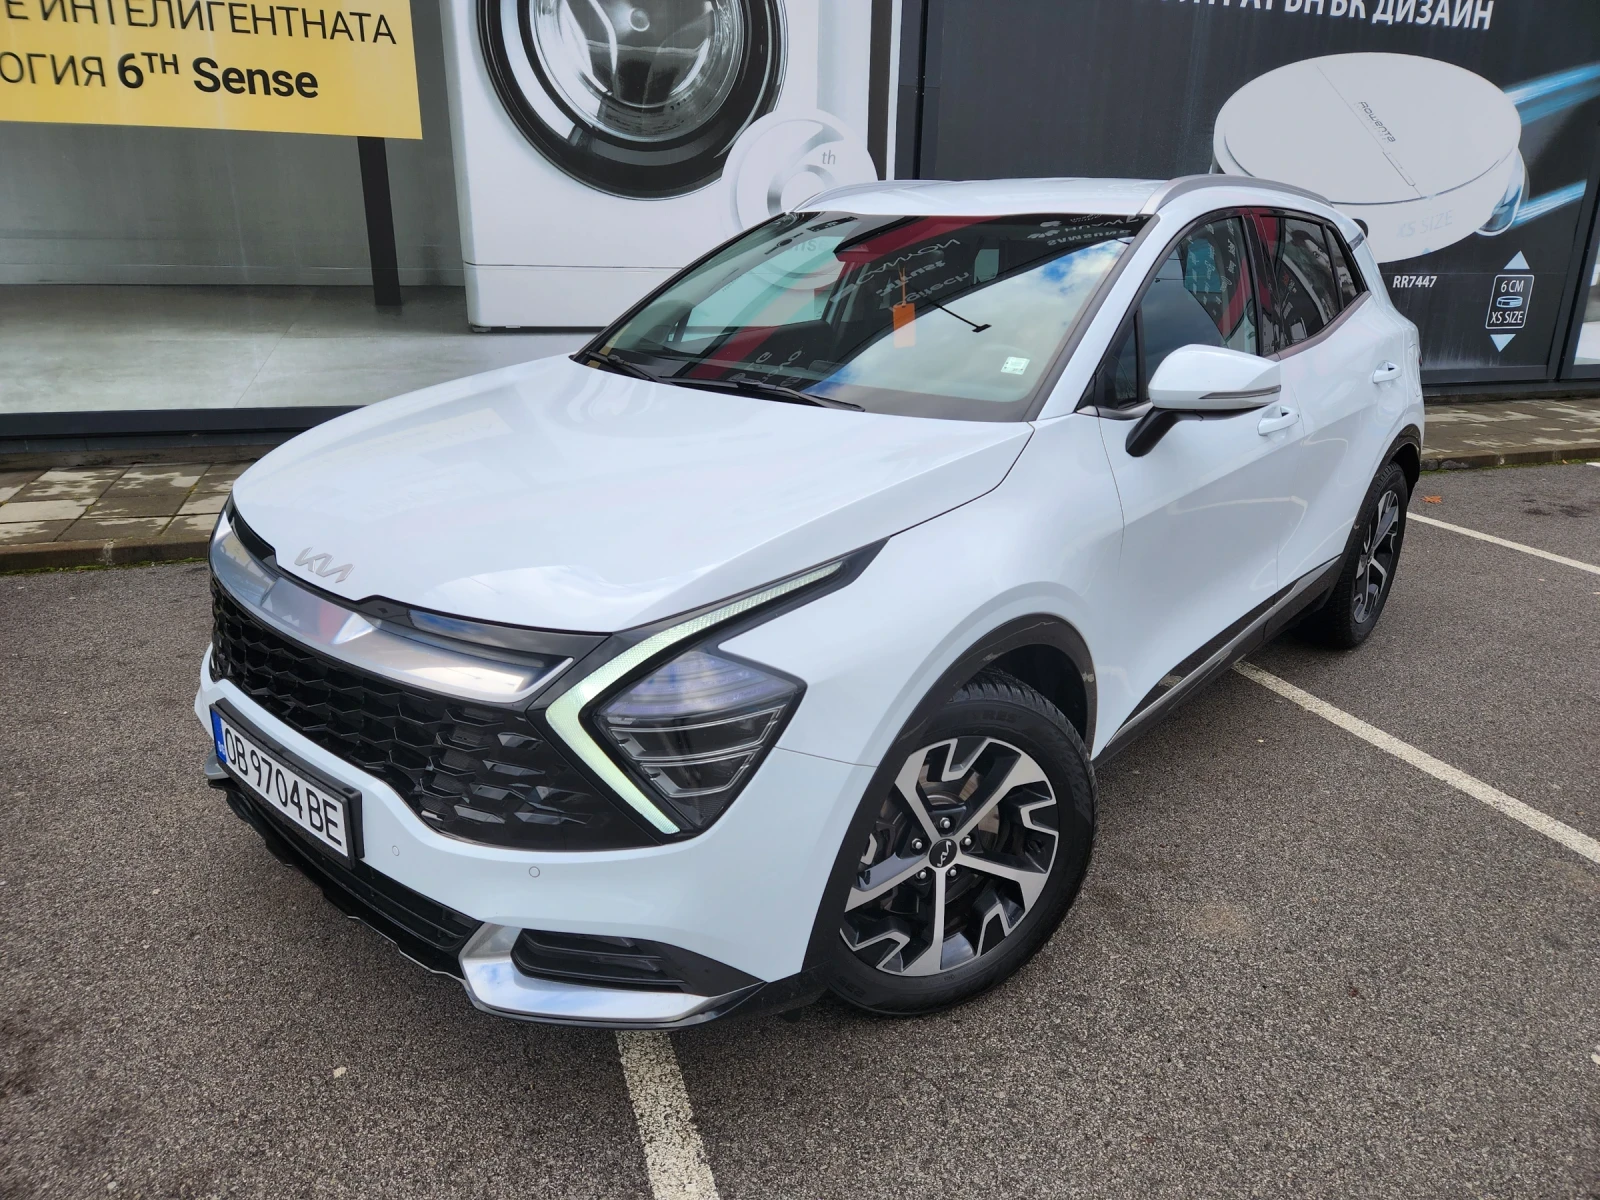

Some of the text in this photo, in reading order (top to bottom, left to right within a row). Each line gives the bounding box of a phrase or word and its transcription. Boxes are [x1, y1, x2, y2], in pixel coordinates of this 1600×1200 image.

[0, 52, 106, 87] ОГИЯ
[192, 57, 319, 98] Sense
[1392, 275, 1438, 288] RR7447
[1501, 280, 1525, 293] 6 CM
[1490, 311, 1524, 323] XS SIZE
